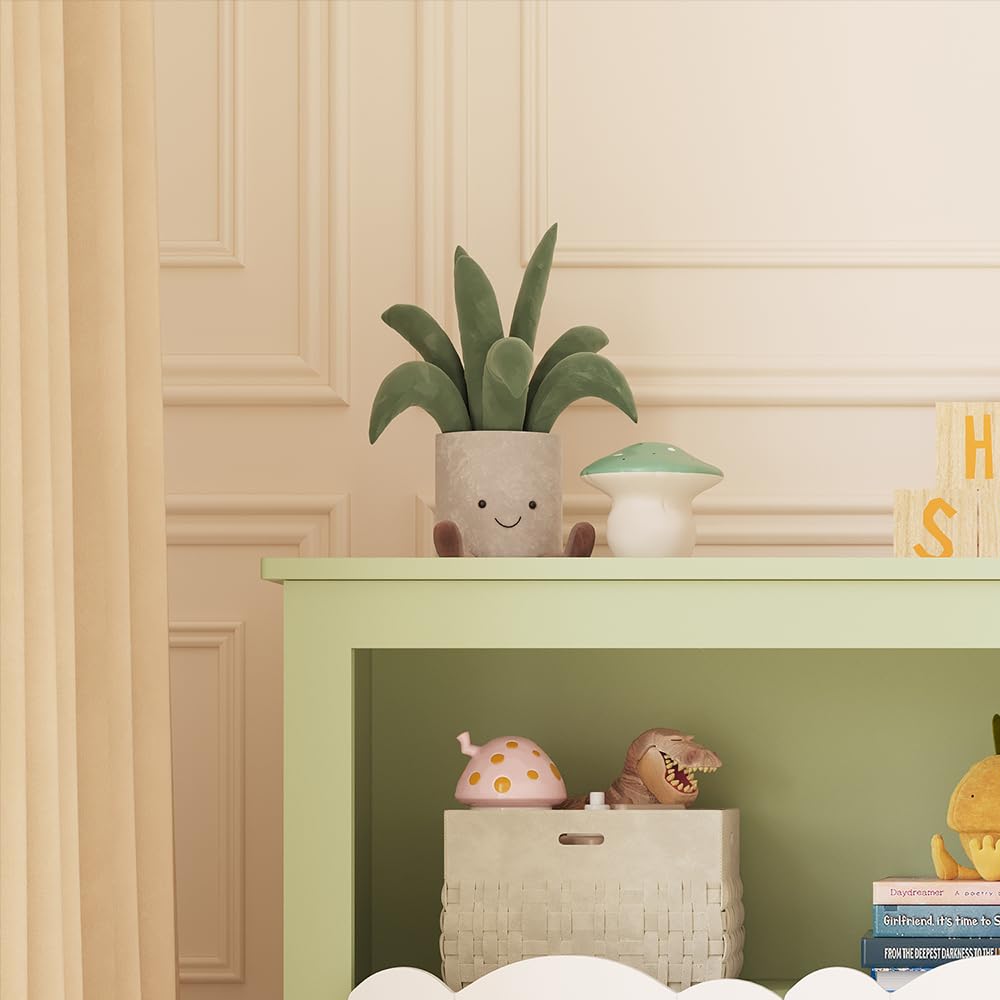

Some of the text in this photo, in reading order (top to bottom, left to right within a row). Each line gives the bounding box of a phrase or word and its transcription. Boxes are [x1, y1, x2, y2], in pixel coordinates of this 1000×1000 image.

[890, 888, 944, 897] Daydreamer
[937, 915, 953, 926] it's
[955, 914, 979, 926] time
[980, 914, 992, 926] to
[884, 947, 902, 959] FROM
[902, 947, 915, 959] THE
[915, 947, 941, 959] DEEPEST
[941, 947, 974, 959] DARKNESS
[974, 947, 983, 957] TO
[983, 947, 995, 957] THE
